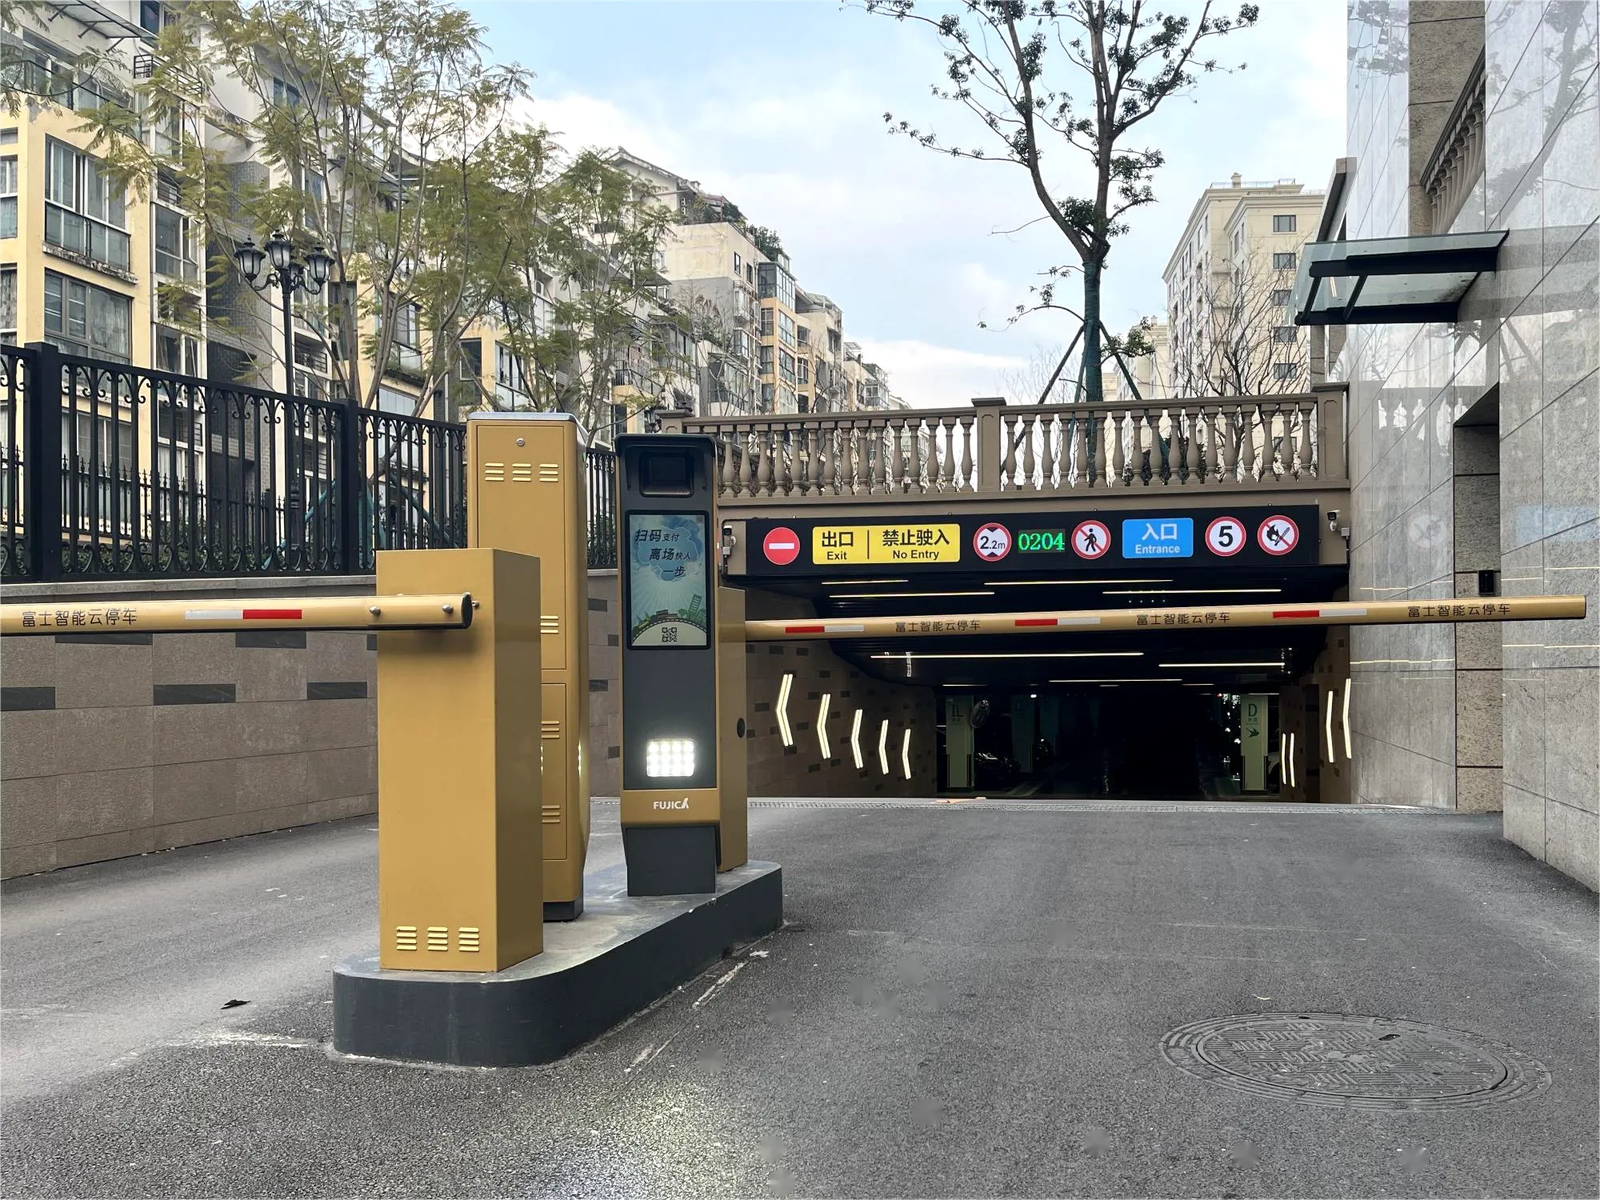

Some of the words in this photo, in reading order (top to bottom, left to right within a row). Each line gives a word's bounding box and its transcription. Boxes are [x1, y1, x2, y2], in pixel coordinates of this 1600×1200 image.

[821, 530, 854, 548] 出口
[882, 529, 950, 546] 禁止驶入
[1141, 523, 1178, 541] 入口
[1218, 525, 1234, 548] 5
[979, 535, 1006, 550] 2.2m
[1018, 532, 1065, 551] 0204
[1135, 543, 1180, 555] Entrance
[826, 551, 848, 561] Exit
[892, 549, 908, 560] No
[910, 549, 940, 561] Entry
[663, 566, 685, 577] 一步
[22, 608, 137, 627] 富士智能云停车
[1407, 603, 1511, 618] 富士智能云停车
[895, 619, 980, 633] 富士智能云停车
[1136, 611, 1231, 626] 富士智能云停车
[1248, 703, 1258, 717] D
[653, 797, 689, 810] FUJICA
